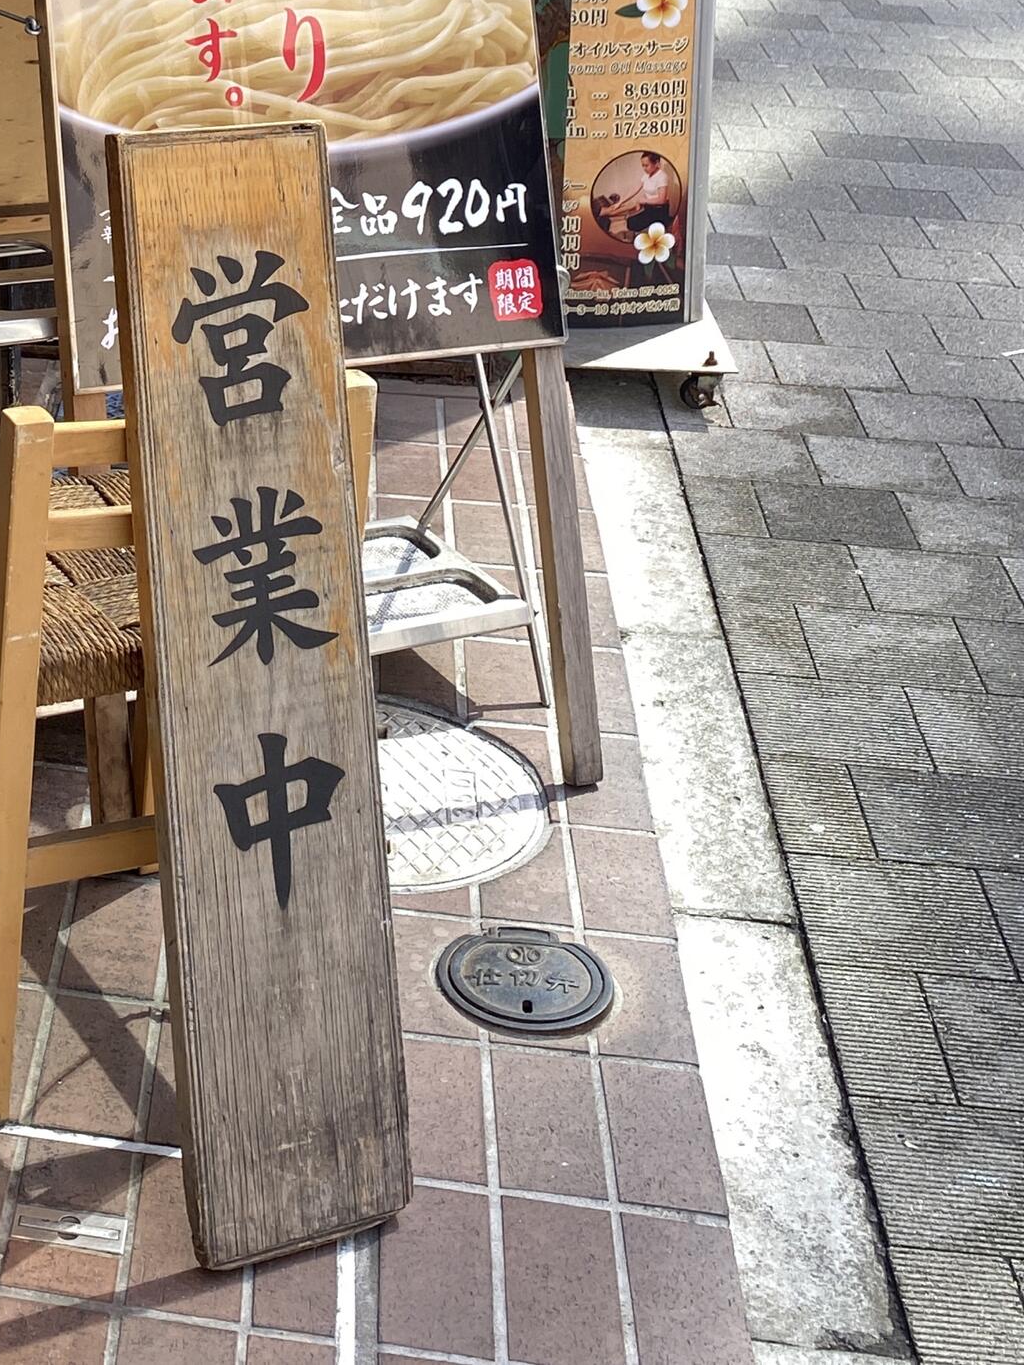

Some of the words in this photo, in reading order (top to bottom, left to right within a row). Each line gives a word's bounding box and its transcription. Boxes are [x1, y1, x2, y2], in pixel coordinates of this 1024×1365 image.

[570, 37, 689, 57] オイルマッサージ
[624, 80, 685, 99] 8,640円
[614, 99, 684, 119] 12,960円
[614, 119, 684, 139] 17,280円
[495, 266, 535, 291] 期間
[497, 292, 538, 317] 限定
[171, 250, 346, 911] 営業中
